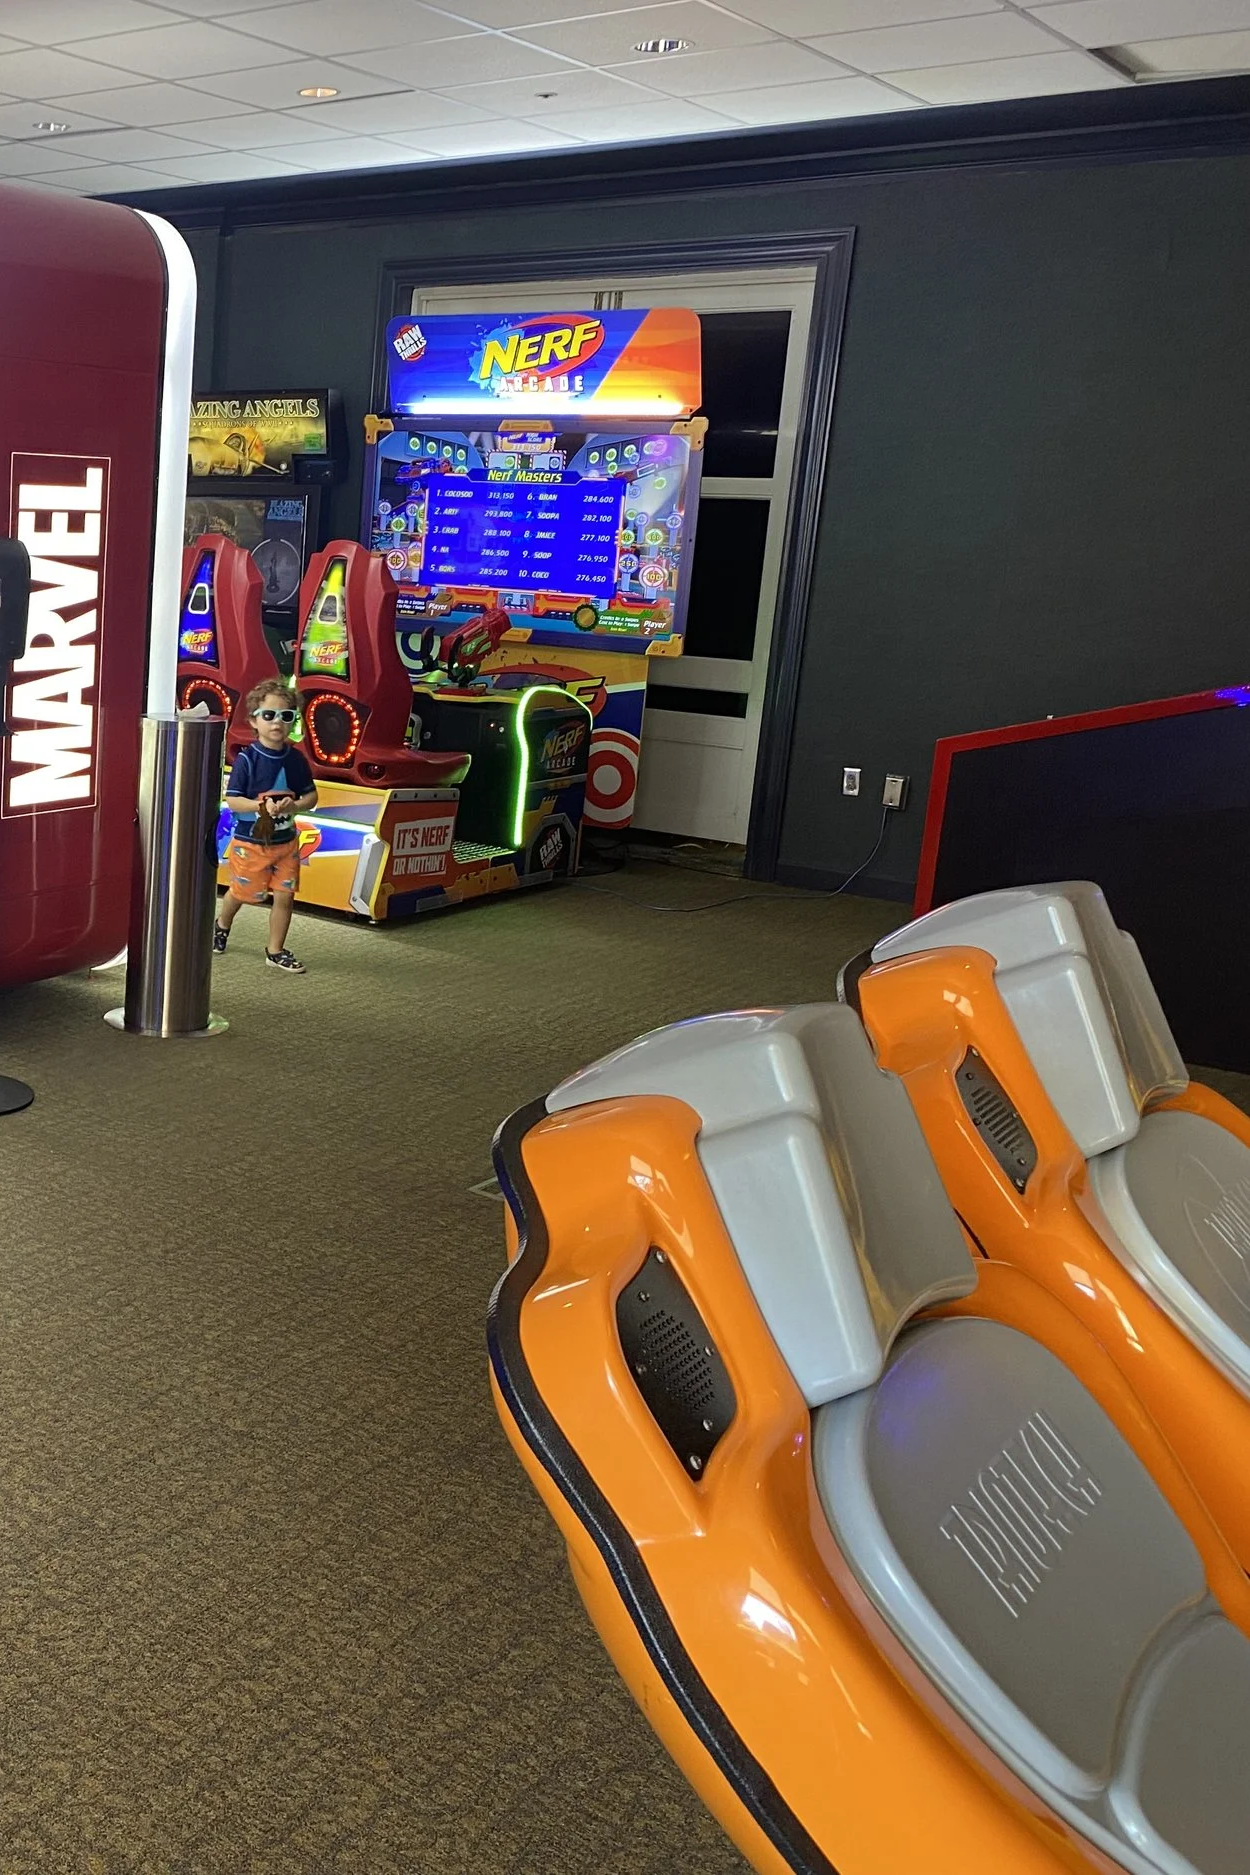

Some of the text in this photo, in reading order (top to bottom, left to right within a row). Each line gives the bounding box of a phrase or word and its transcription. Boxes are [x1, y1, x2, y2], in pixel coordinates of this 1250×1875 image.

[393, 325, 423, 354] RAW
[399, 337, 427, 360] THRILLS
[479, 319, 601, 380] NERF
[500, 375, 584, 392] ARCADE
[243, 398, 320, 419] ANGELS
[487, 470, 562, 483] Nerf Masters
[527, 493, 535, 501] 6.
[583, 495, 614, 504] 284,600
[434, 507, 442, 515] 2.
[525, 511, 534, 519] 7.
[582, 514, 612, 523] 282,100
[432, 525, 441, 534] 3.
[580, 533, 611, 542] 277,100
[431, 545, 439, 553] 4.
[522, 550, 531, 559] 9.
[577, 554, 609, 563] 276,950
[429, 564, 438, 572] 5.
[575, 574, 607, 583] 276,450
[643, 620, 667, 629] Player
[9, 467, 104, 807] MARVEL
[183, 631, 213, 646] NERF
[310, 643, 343, 657] NERF
[540, 724, 585, 763] NERF
[546, 756, 577, 770] ARCADE
[396, 825, 450, 850] IT'S NERF
[539, 827, 561, 858] RAW
[392, 857, 406, 876] OR
